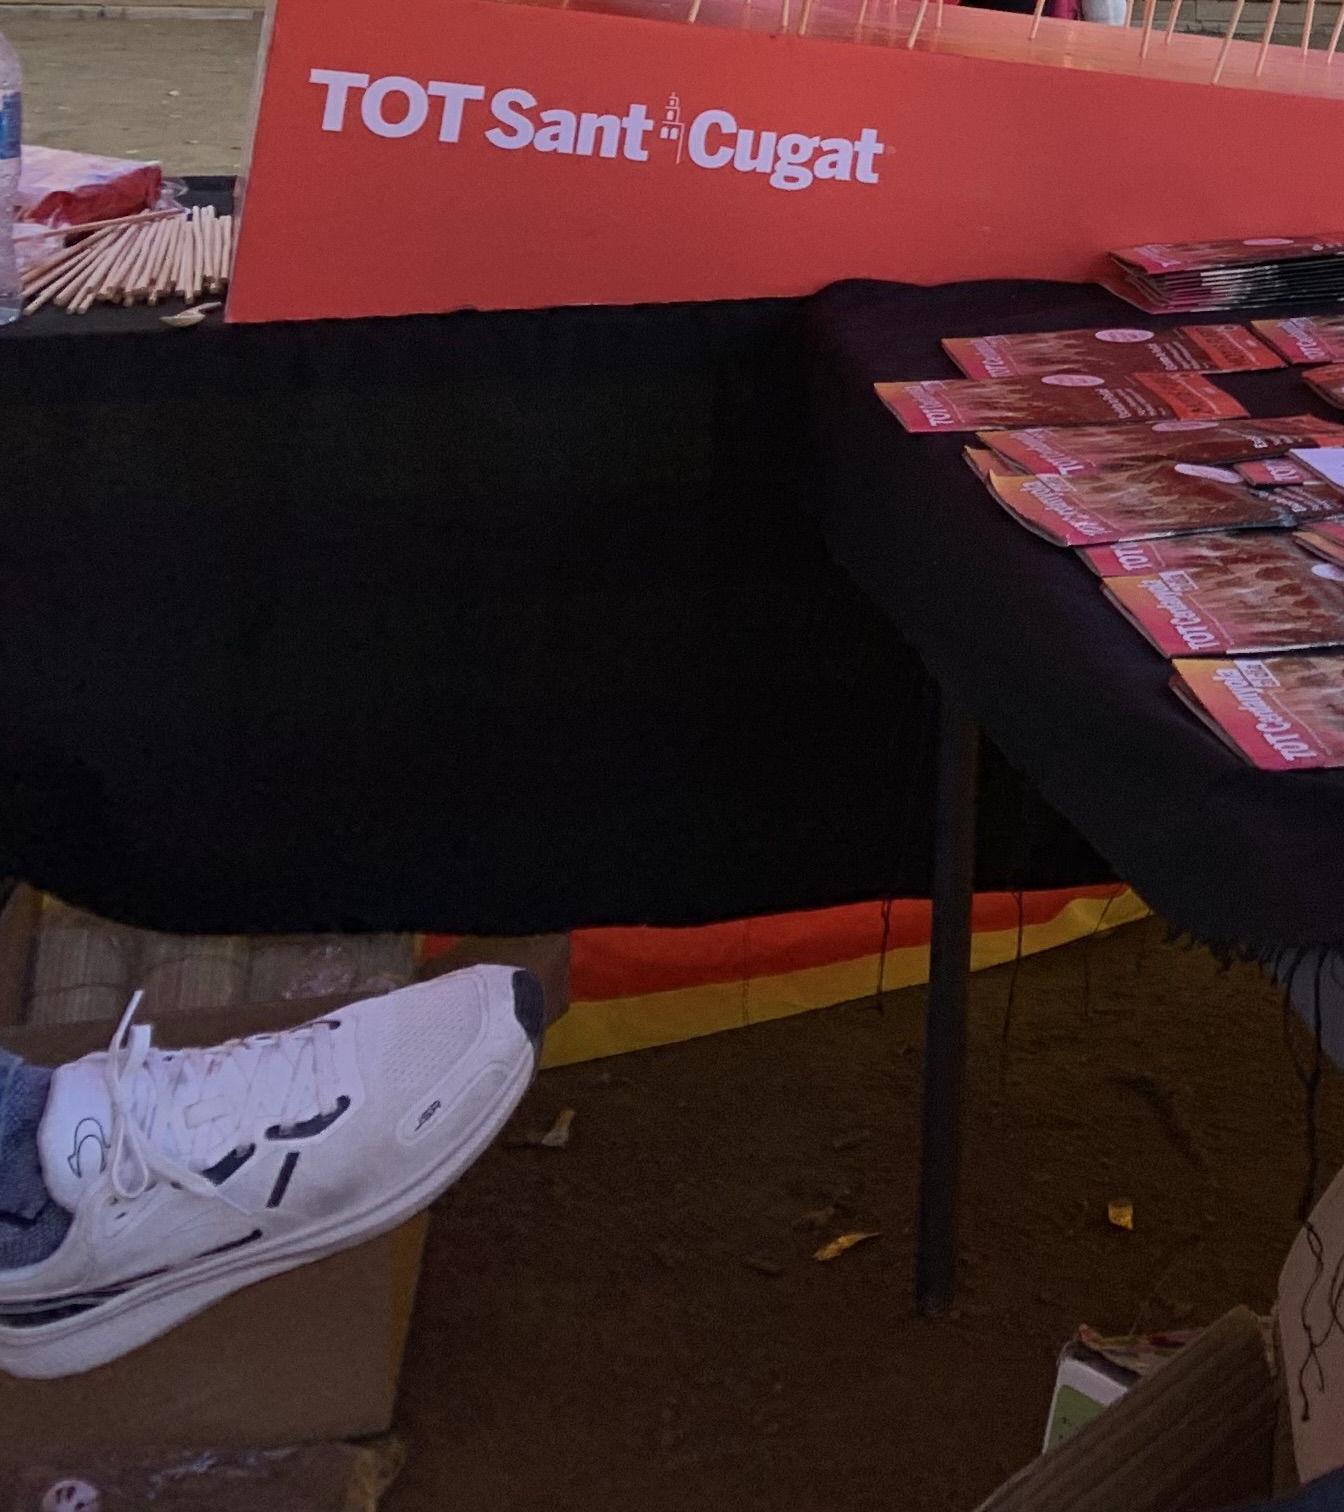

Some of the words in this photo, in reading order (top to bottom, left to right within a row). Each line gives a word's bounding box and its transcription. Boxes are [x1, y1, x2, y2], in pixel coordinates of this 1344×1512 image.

[310, 68, 485, 143] TOT
[485, 88, 653, 162] Sant
[687, 109, 884, 191] Cugat
[1260, 718, 1317, 762] TOT
